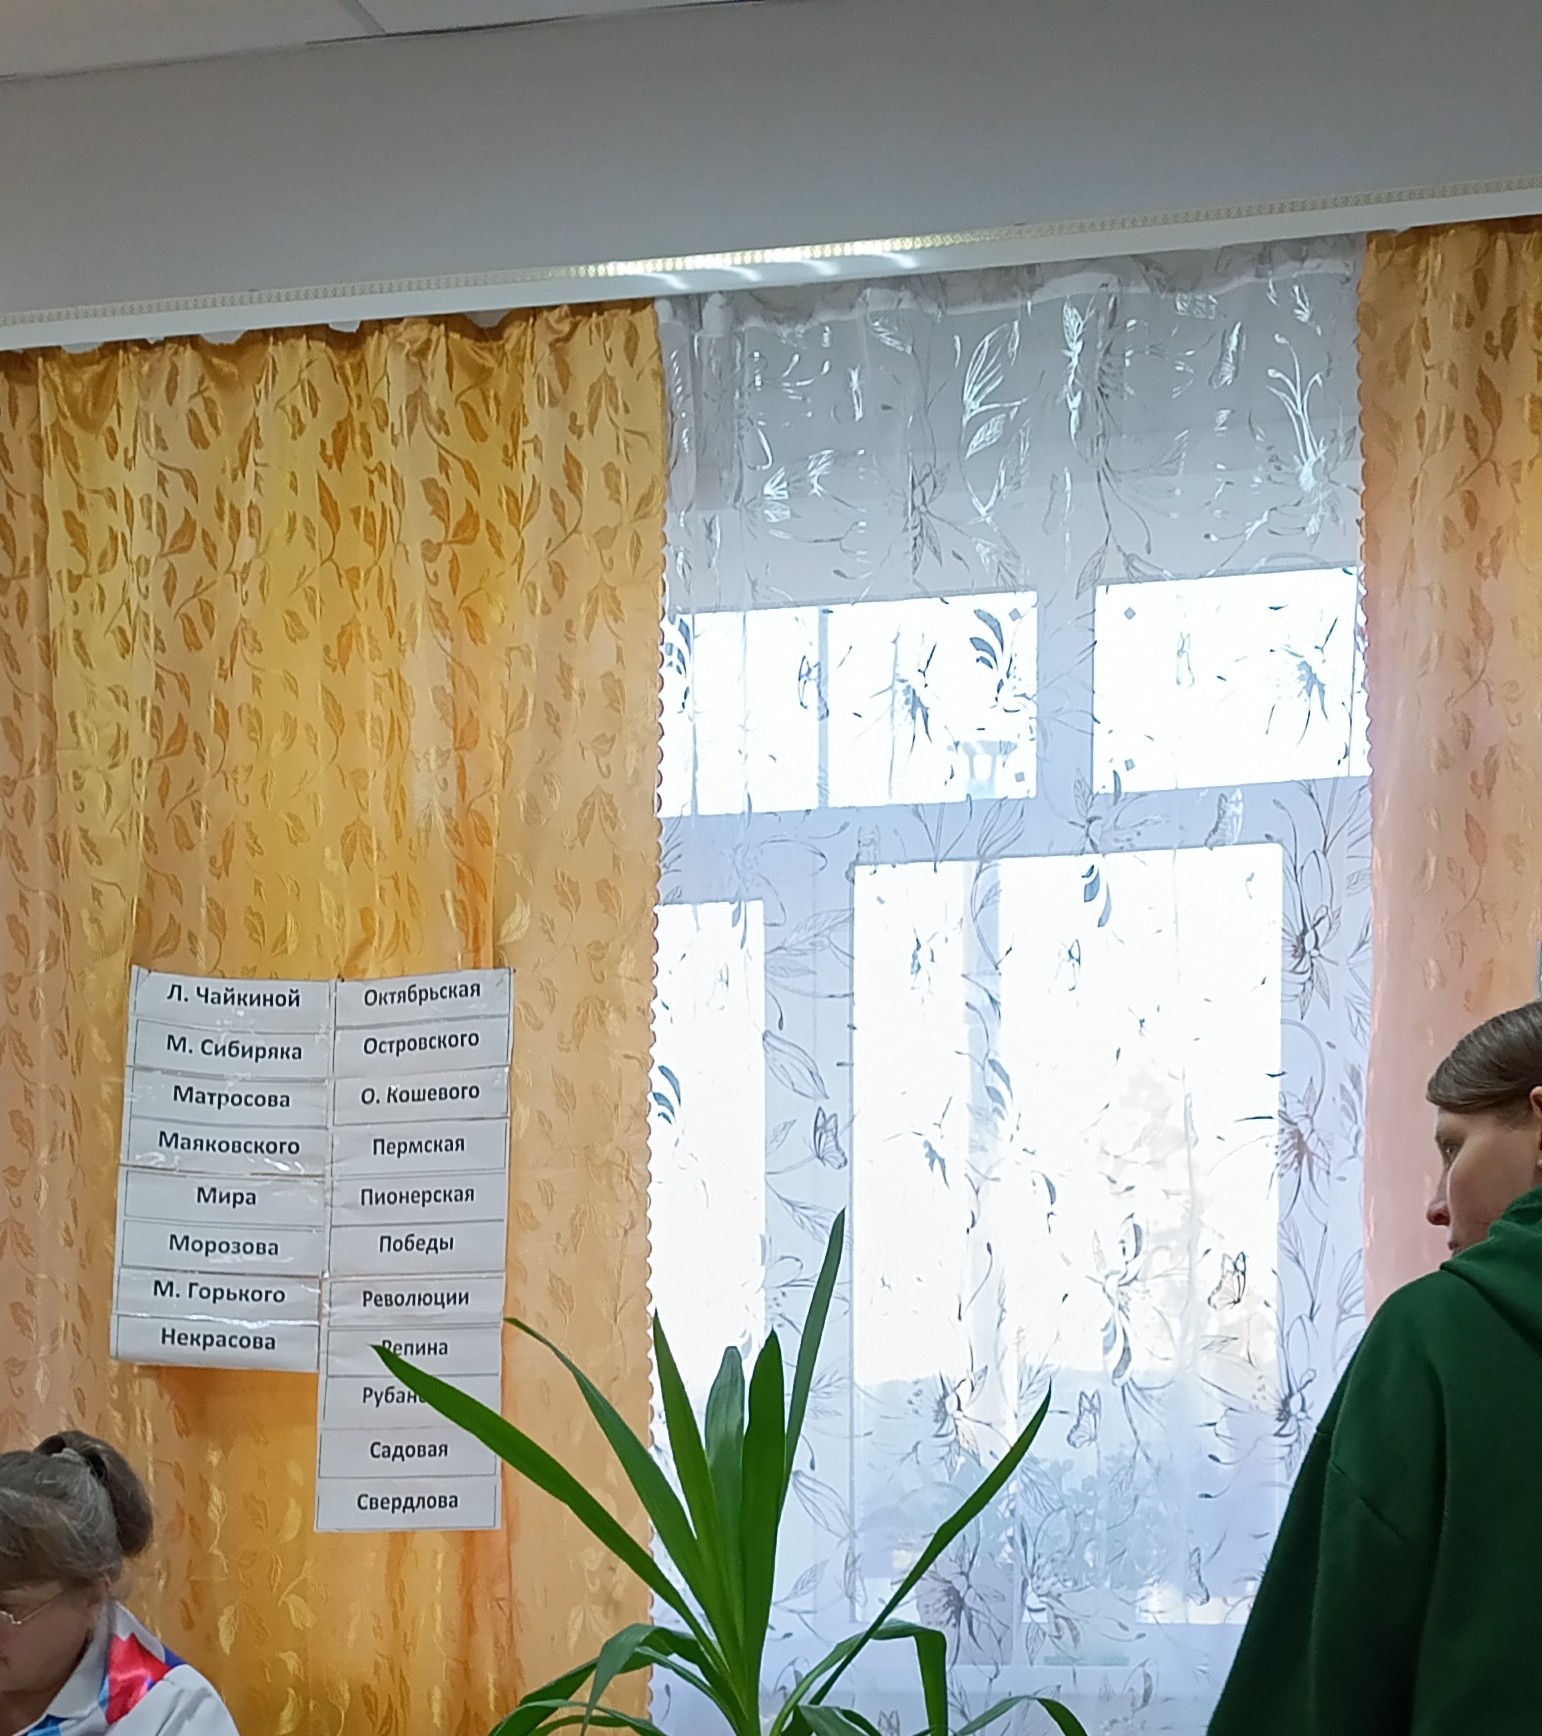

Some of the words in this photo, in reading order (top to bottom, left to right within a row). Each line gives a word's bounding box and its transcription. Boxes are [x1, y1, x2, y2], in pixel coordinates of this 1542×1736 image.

[166, 983, 189, 1003] Л.
[196, 986, 300, 1008] Чайкиной
[364, 983, 481, 1007] Октябрьская
[166, 1034, 196, 1054] М.
[200, 1038, 302, 1064] Сибиряка
[363, 1032, 480, 1058] Островского
[173, 1084, 290, 1111] Матросова
[361, 1087, 381, 1105] О.
[386, 1085, 480, 1104] Кошевого
[158, 1130, 300, 1155] Маяковского
[373, 1138, 465, 1159] Пермская
[196, 1186, 256, 1209] Мира
[361, 1188, 475, 1208] Пионерская
[169, 1233, 279, 1258] Морозова
[379, 1233, 454, 1255] Победы
[153, 1279, 180, 1298] М.
[188, 1282, 286, 1305] Горького
[362, 1290, 469, 1310] Революции
[161, 1327, 276, 1352] Некрасова
[370, 1441, 448, 1462] Садовая
[357, 1493, 458, 1514] Свердлова
